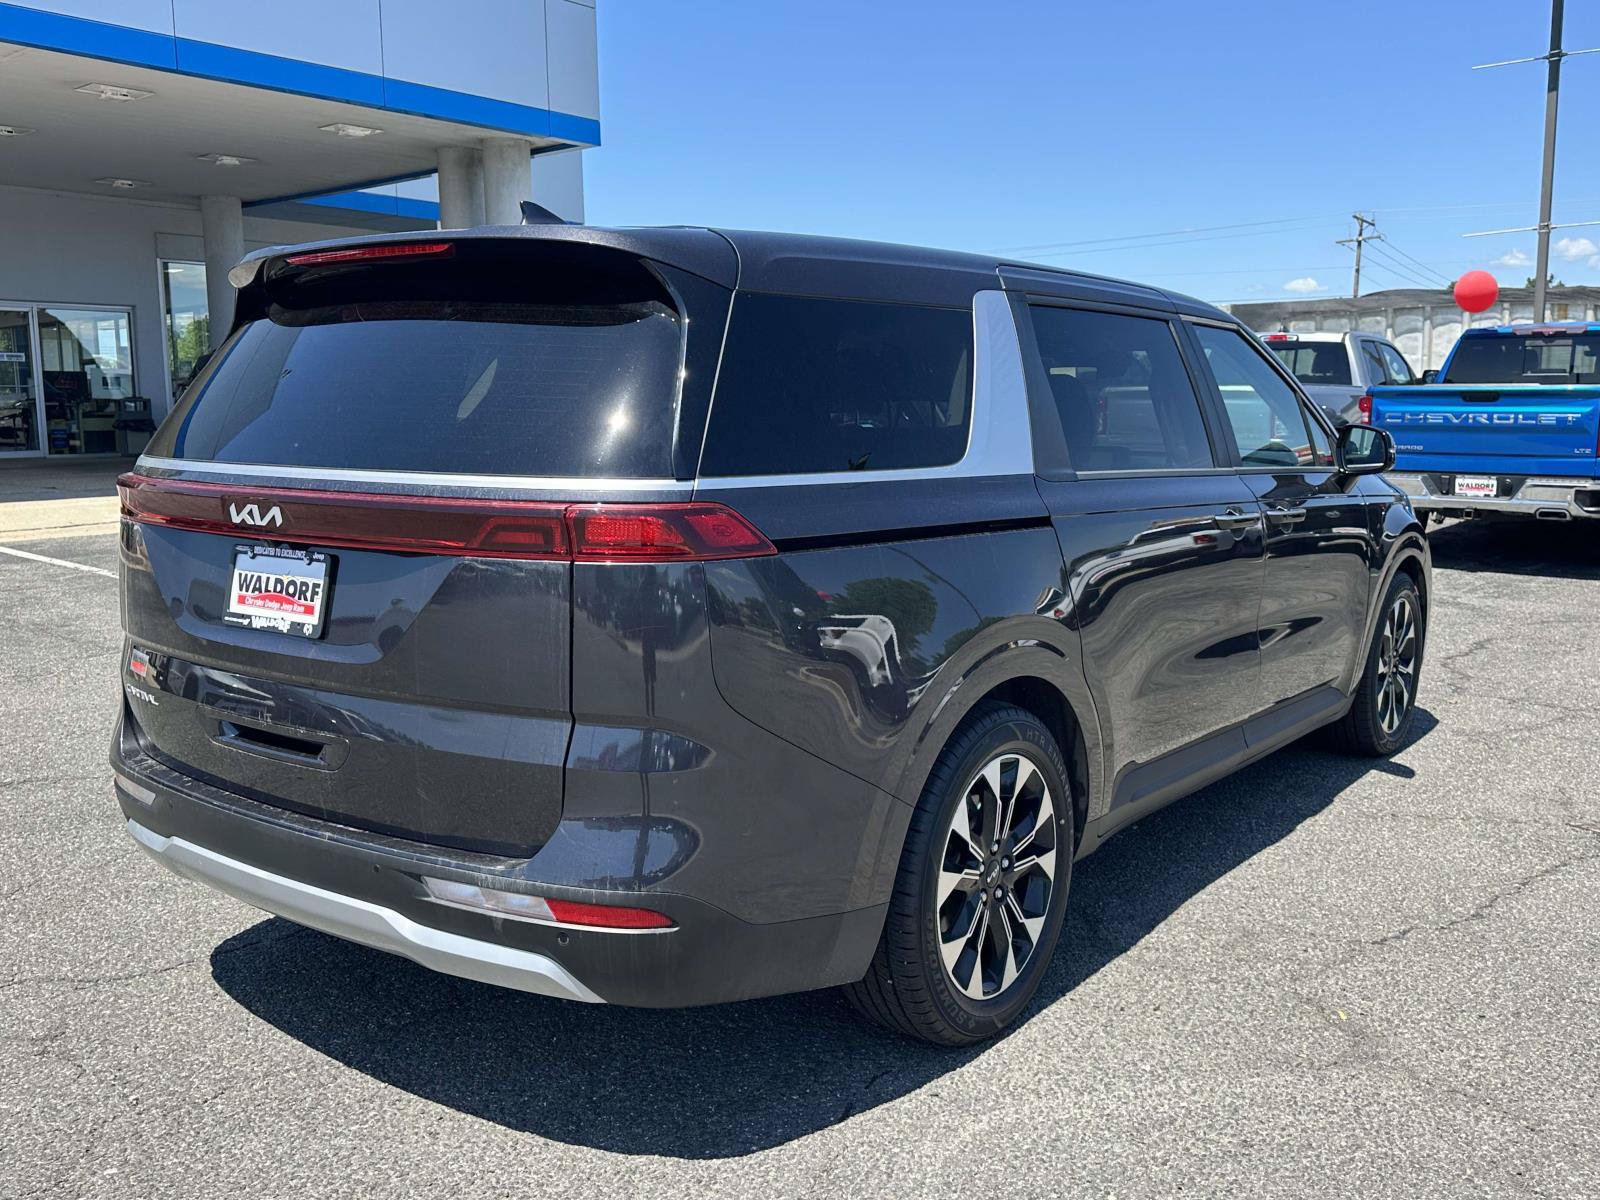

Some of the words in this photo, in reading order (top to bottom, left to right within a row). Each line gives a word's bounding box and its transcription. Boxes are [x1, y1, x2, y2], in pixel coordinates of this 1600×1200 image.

[1384, 412, 1581, 425] CHEVROLET
[229, 502, 283, 527] KIA
[281, 549, 306, 559] EXCELLENCE
[312, 552, 325, 560] Jeep
[238, 572, 321, 602] WALDORF
[245, 597, 264, 608] Chrysler
[265, 600, 280, 610] Dodge
[281, 601, 293, 612] Jeep
[293, 604, 305, 613] Ram
